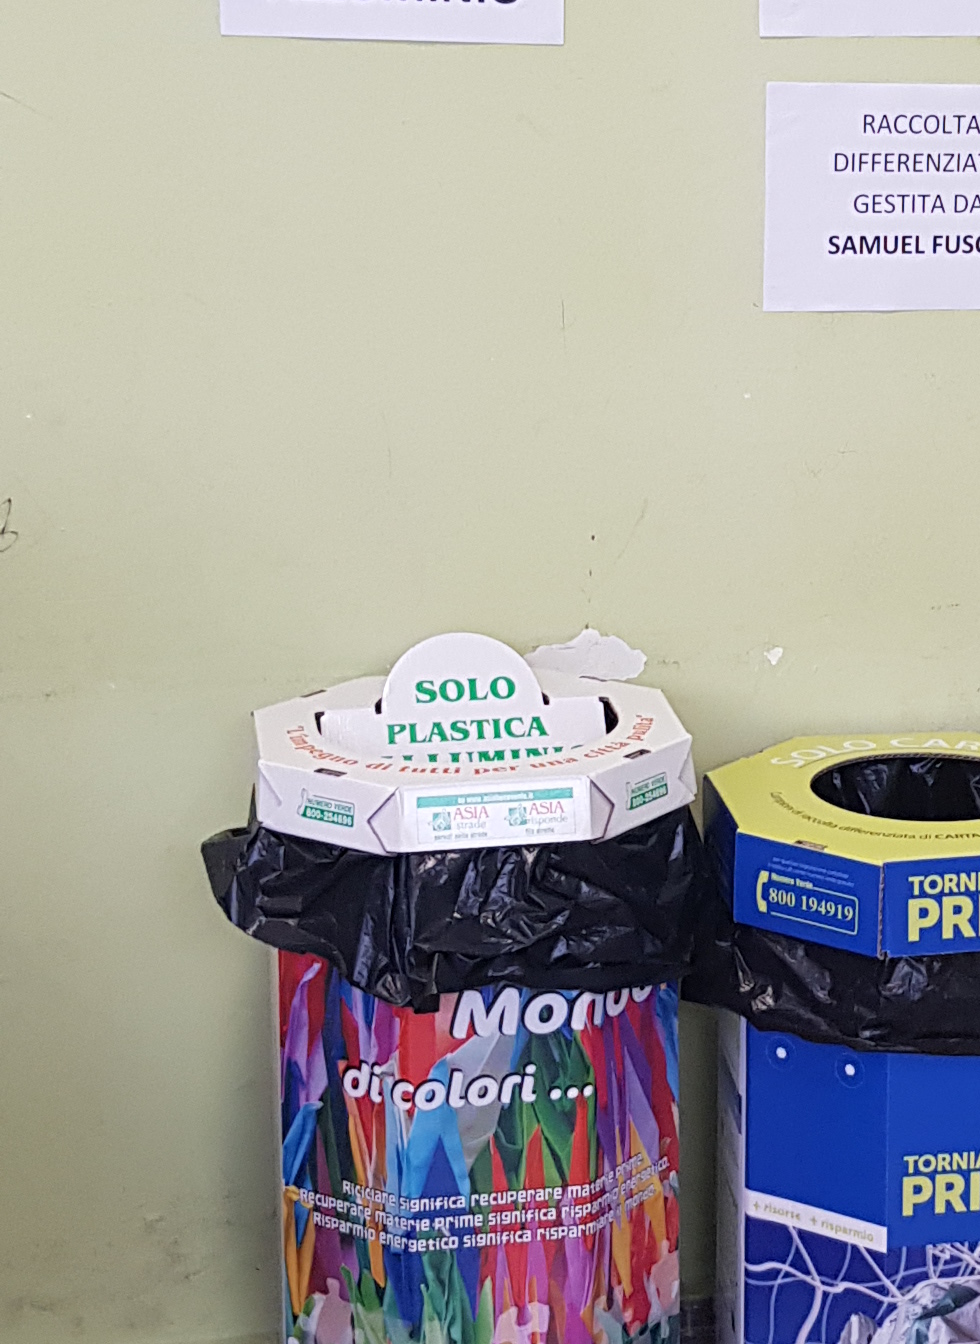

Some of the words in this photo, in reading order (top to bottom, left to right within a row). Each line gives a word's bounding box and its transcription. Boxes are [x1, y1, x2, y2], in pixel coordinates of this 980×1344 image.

[862, 113, 980, 137] RACCOLTA
[853, 192, 946, 215] GESTITA
[827, 233, 926, 256] SAMUEL
[415, 676, 516, 704] SOLO
[387, 716, 549, 745] PLASTICA
[399, 766, 460, 774] tutti
[474, 766, 519, 775] per
[530, 758, 578, 769] una
[771, 740, 876, 768] SOLO
[453, 806, 489, 820] ASIA
[529, 801, 565, 815] ASIA
[769, 888, 796, 907] 800
[801, 896, 853, 921] 194919
[342, 1061, 383, 1104] di
[391, 1062, 538, 1112] colori
[342, 1179, 396, 1206] Riciclare
[399, 1195, 466, 1213] significa
[471, 1186, 562, 1206] recuperare
[568, 1169, 614, 1197] materie
[300, 1188, 372, 1219] Recuperare
[375, 1209, 430, 1232] materie
[434, 1214, 483, 1231] prime
[488, 1209, 557, 1227] significa
[561, 1190, 619, 1219] risparmio
[313, 1211, 376, 1241] Risparmio
[379, 1232, 458, 1252] energetico
[463, 1230, 532, 1247] significa
[537, 1210, 614, 1241] risparmiare
[821, 1218, 875, 1242] risparmio
